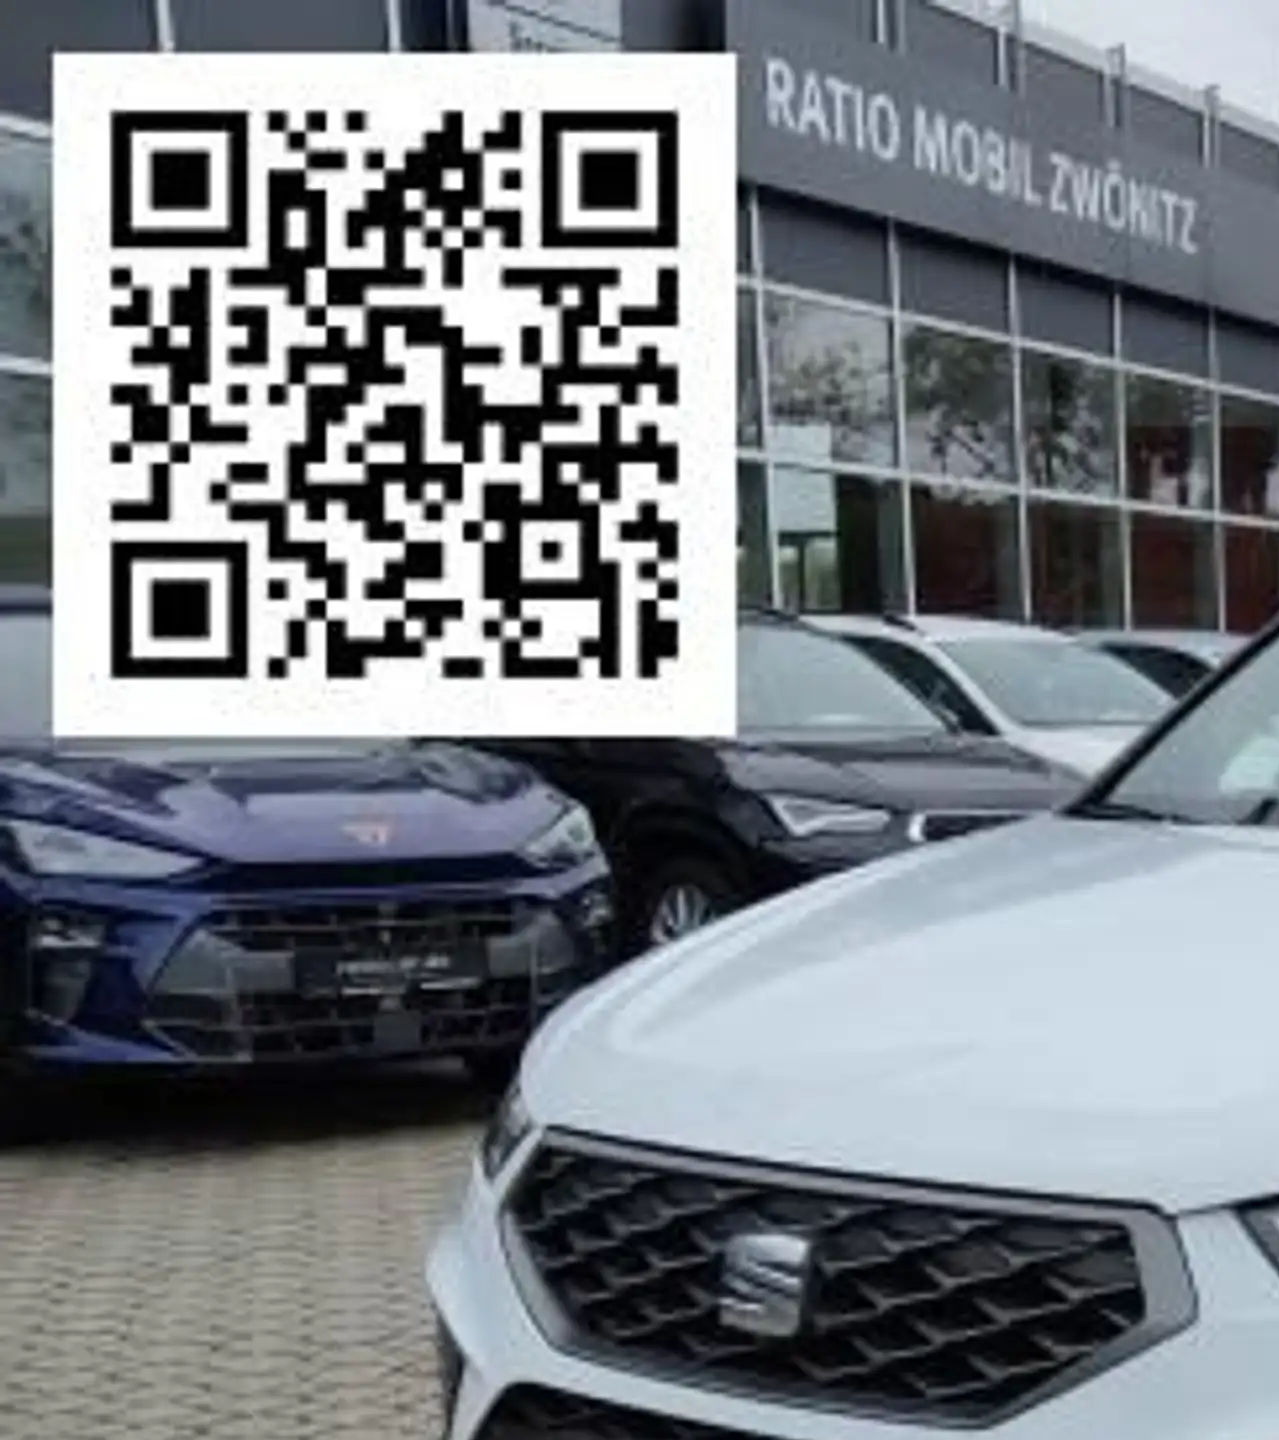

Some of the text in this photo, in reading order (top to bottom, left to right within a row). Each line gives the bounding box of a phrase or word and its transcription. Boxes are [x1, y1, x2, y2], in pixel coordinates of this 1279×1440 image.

[764, 57, 1199, 255] RATIO MOBIL ZWÖNITZ
